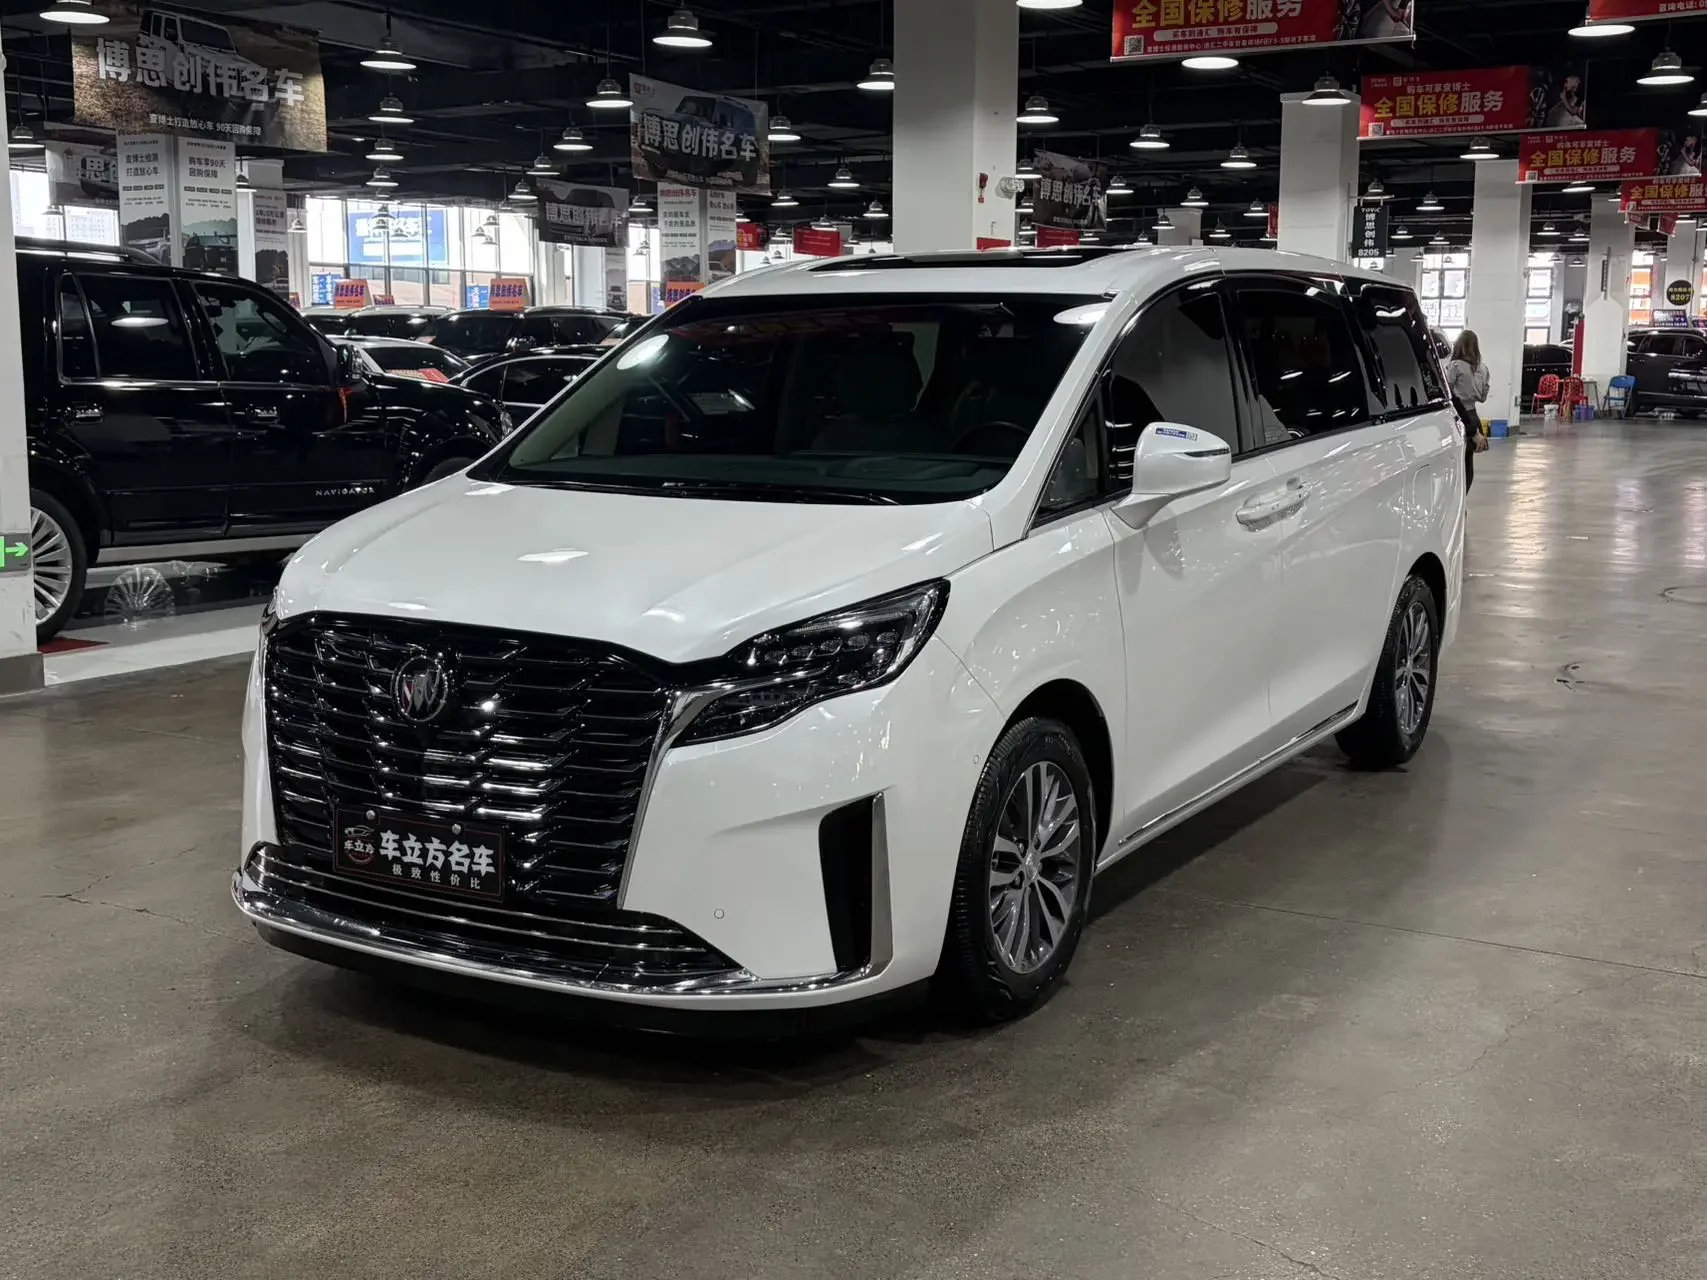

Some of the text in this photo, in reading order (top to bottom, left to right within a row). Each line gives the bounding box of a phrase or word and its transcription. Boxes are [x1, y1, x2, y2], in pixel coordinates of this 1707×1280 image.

[96, 37, 304, 107] 博思创伟名车
[1374, 90, 1504, 118] 全国保修服务
[643, 113, 757, 162] 博思创伟名车
[1530, 146, 1637, 168] 全国保修服务
[1040, 178, 1101, 208] 博思创伟名车
[1630, 183, 1707, 200] 全国保修服
[1358, 248, 1380, 256] 8205
[315, 486, 375, 496] NAVIGATOR
[379, 829, 496, 877] 车立方名车
[392, 863, 481, 889] 极致性价比
